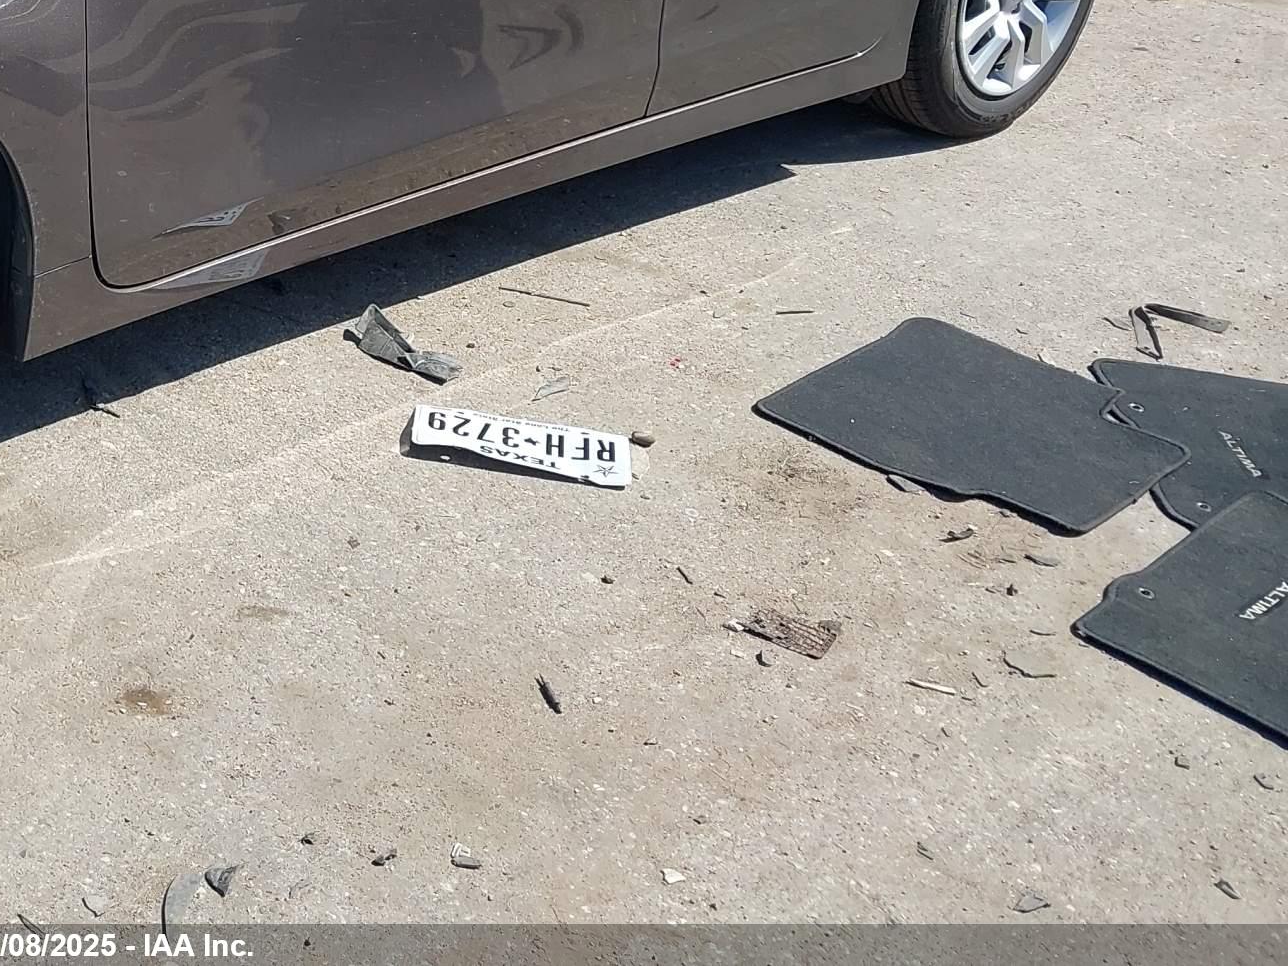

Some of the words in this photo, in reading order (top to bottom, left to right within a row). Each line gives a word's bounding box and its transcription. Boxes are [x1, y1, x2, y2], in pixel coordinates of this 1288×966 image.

[479, 444, 561, 470] TEXAS
[1217, 430, 1262, 478] ALTIMA
[1238, 581, 1288, 620] ALTIMA
